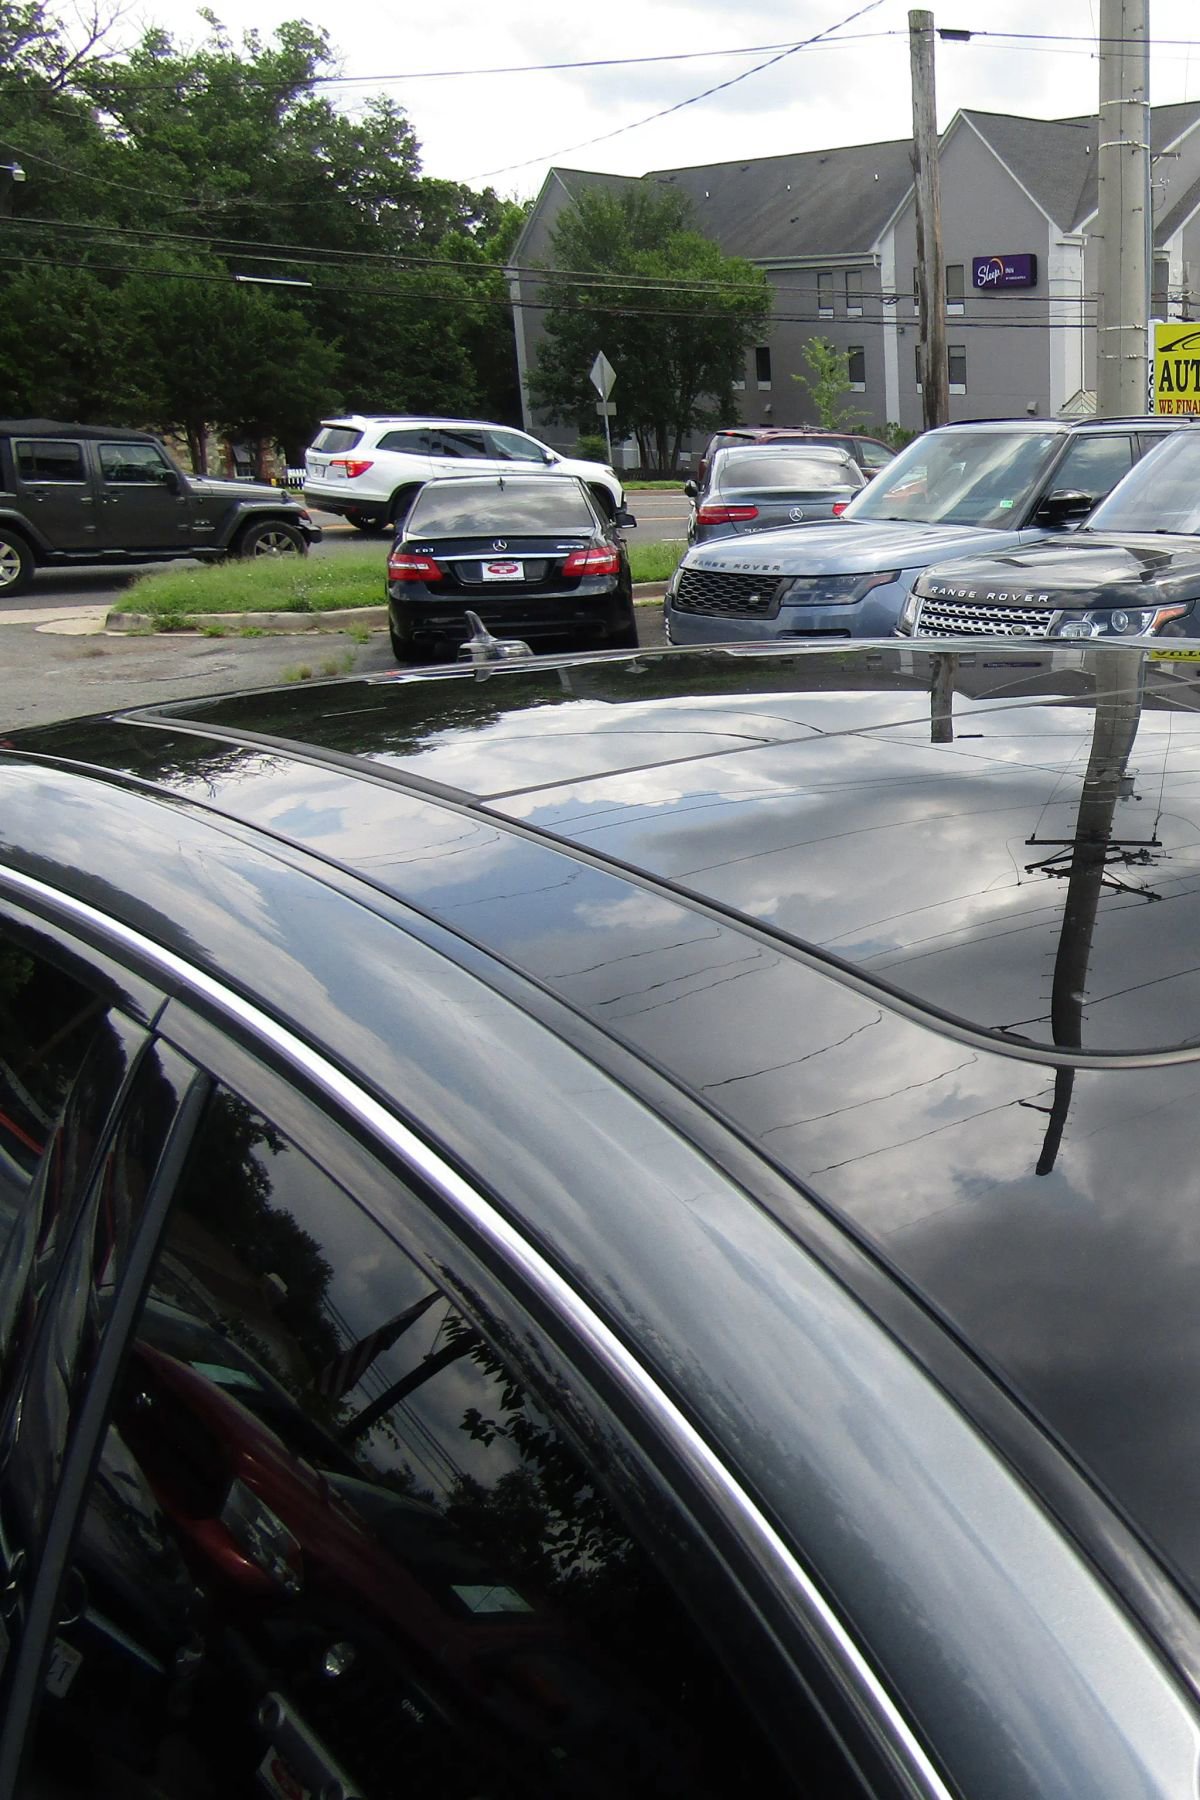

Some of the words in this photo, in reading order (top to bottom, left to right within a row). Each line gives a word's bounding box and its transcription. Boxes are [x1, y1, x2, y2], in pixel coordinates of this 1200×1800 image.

[978, 265, 1001, 286] Sleep
[1158, 400, 1173, 415] WE
[692, 559, 726, 569] RANGE
[733, 563, 781, 572] ROVER
[930, 586, 977, 599] RANGE
[986, 592, 1049, 603] ROVER
